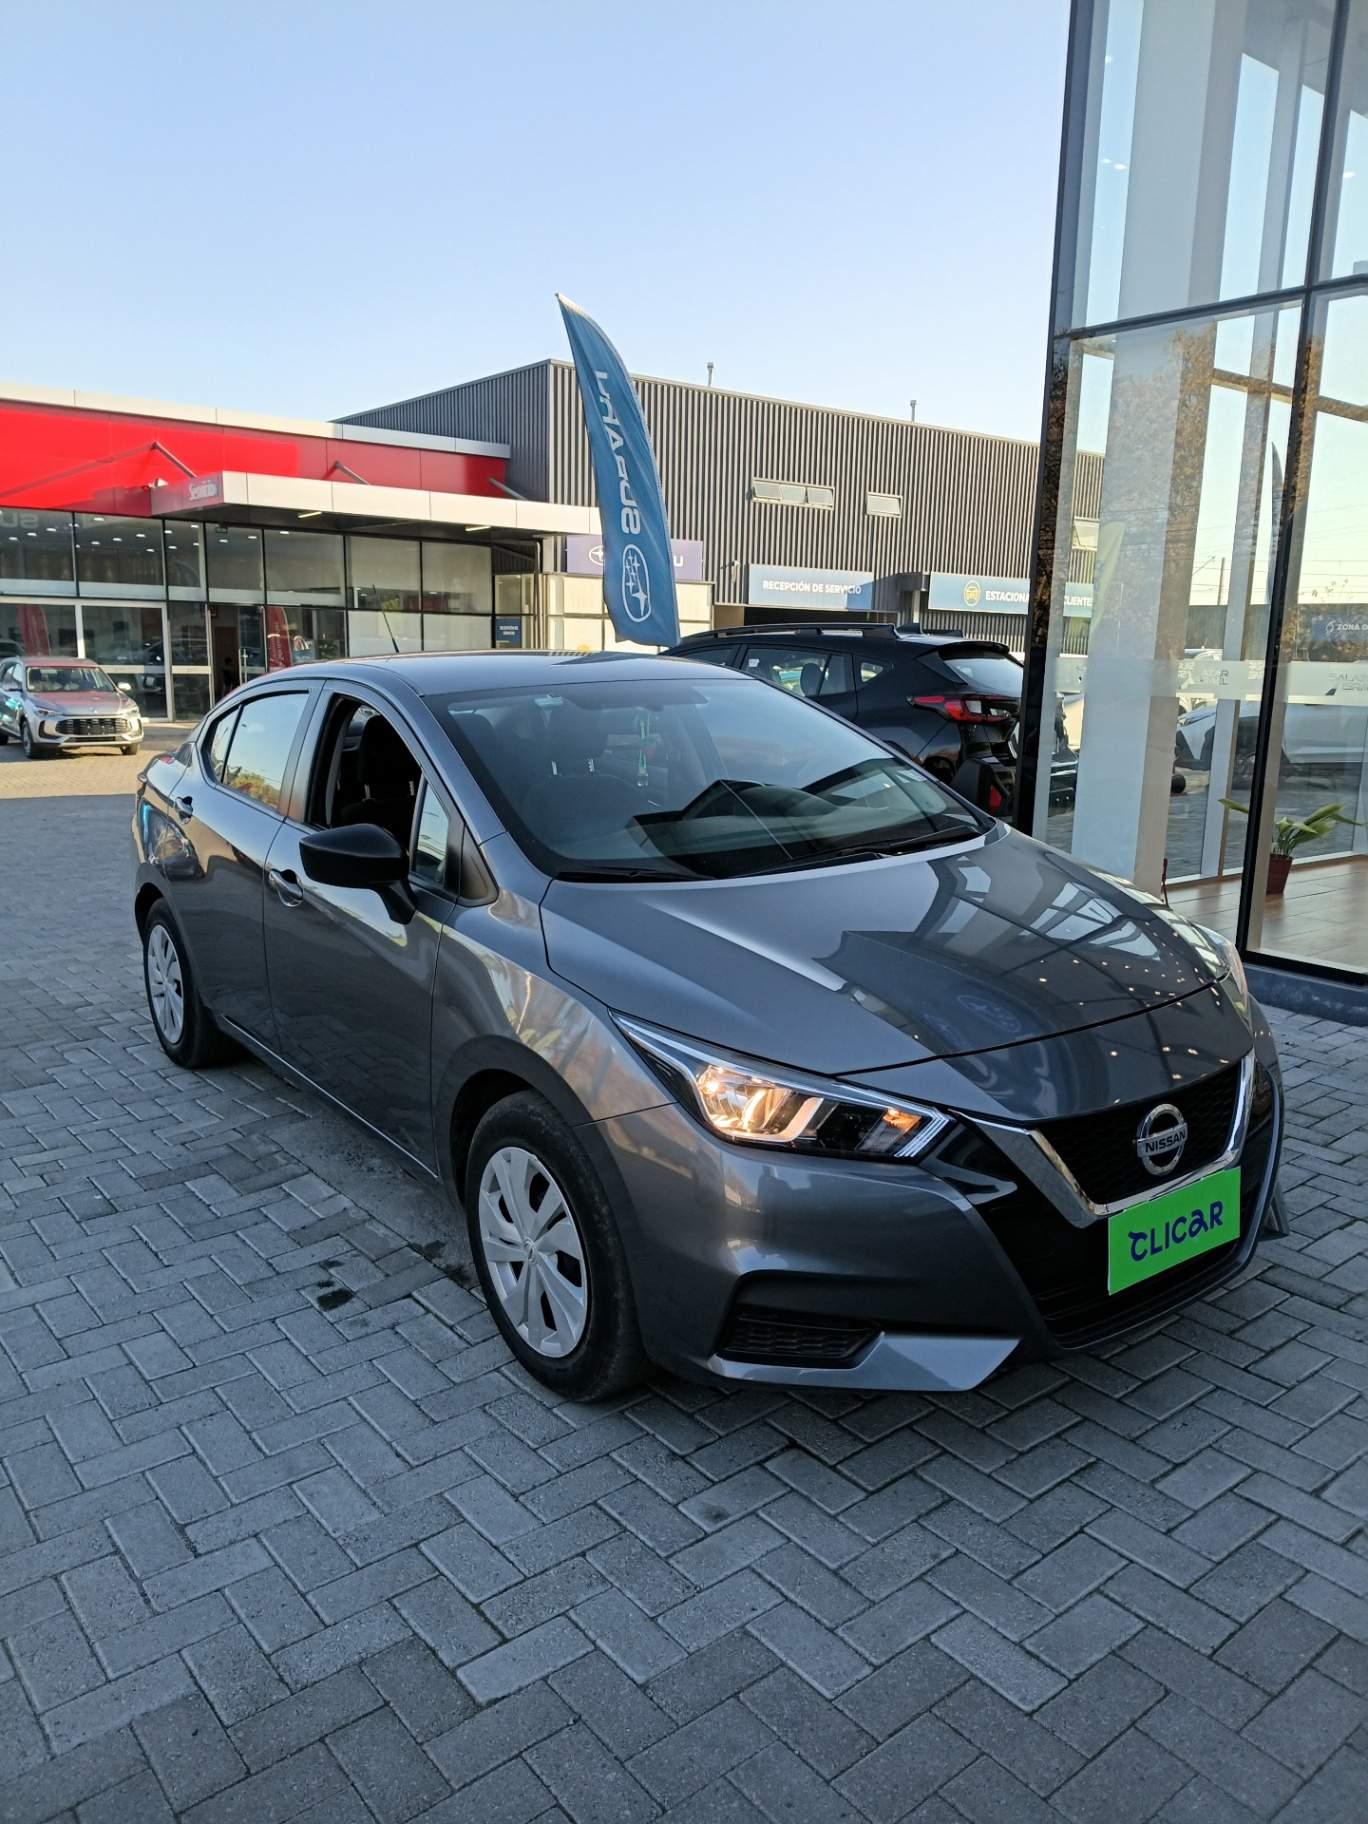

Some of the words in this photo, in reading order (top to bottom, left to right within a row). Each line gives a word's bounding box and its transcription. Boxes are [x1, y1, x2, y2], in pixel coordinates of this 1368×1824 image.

[762, 580, 811, 592] RECEPCIÓN
[812, 584, 824, 593] DE
[824, 584, 862, 595] SERVICIO
[1145, 1130, 1186, 1153] NISSAN
